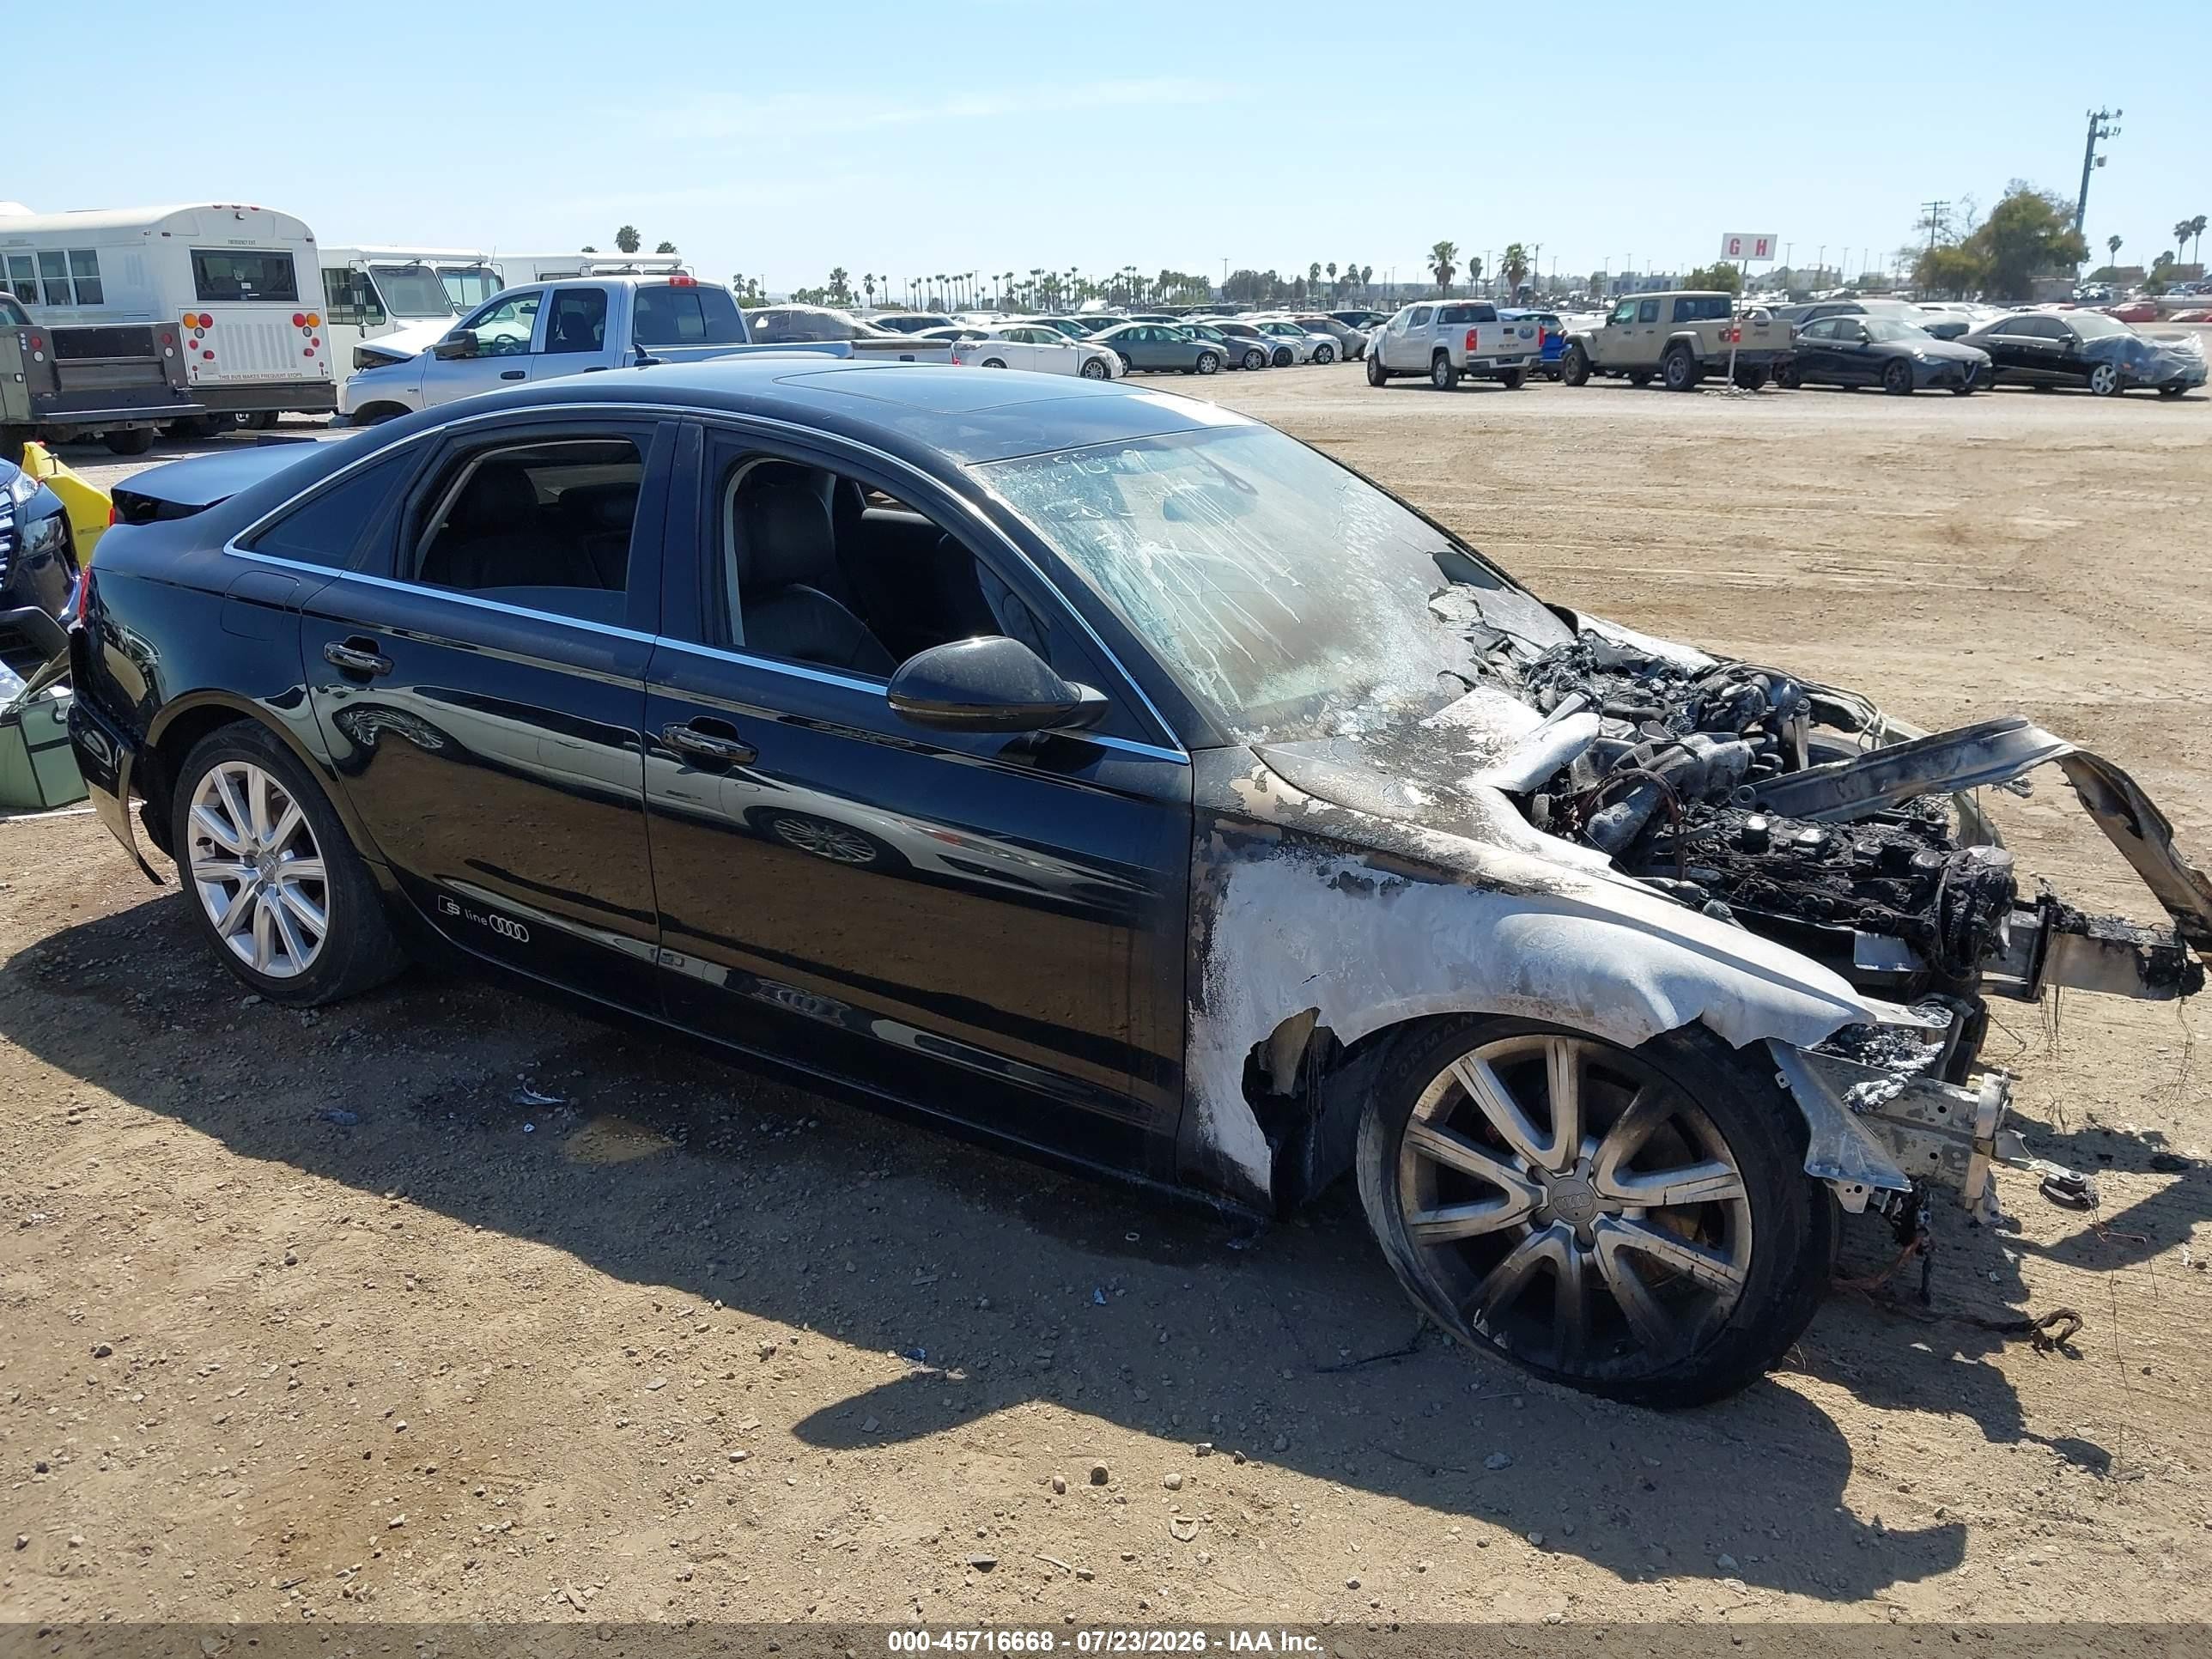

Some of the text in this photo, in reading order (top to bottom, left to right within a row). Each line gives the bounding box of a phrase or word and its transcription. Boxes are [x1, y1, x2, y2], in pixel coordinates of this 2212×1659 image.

[1729, 238, 1767, 256] G H
[464, 908, 488, 927] line
